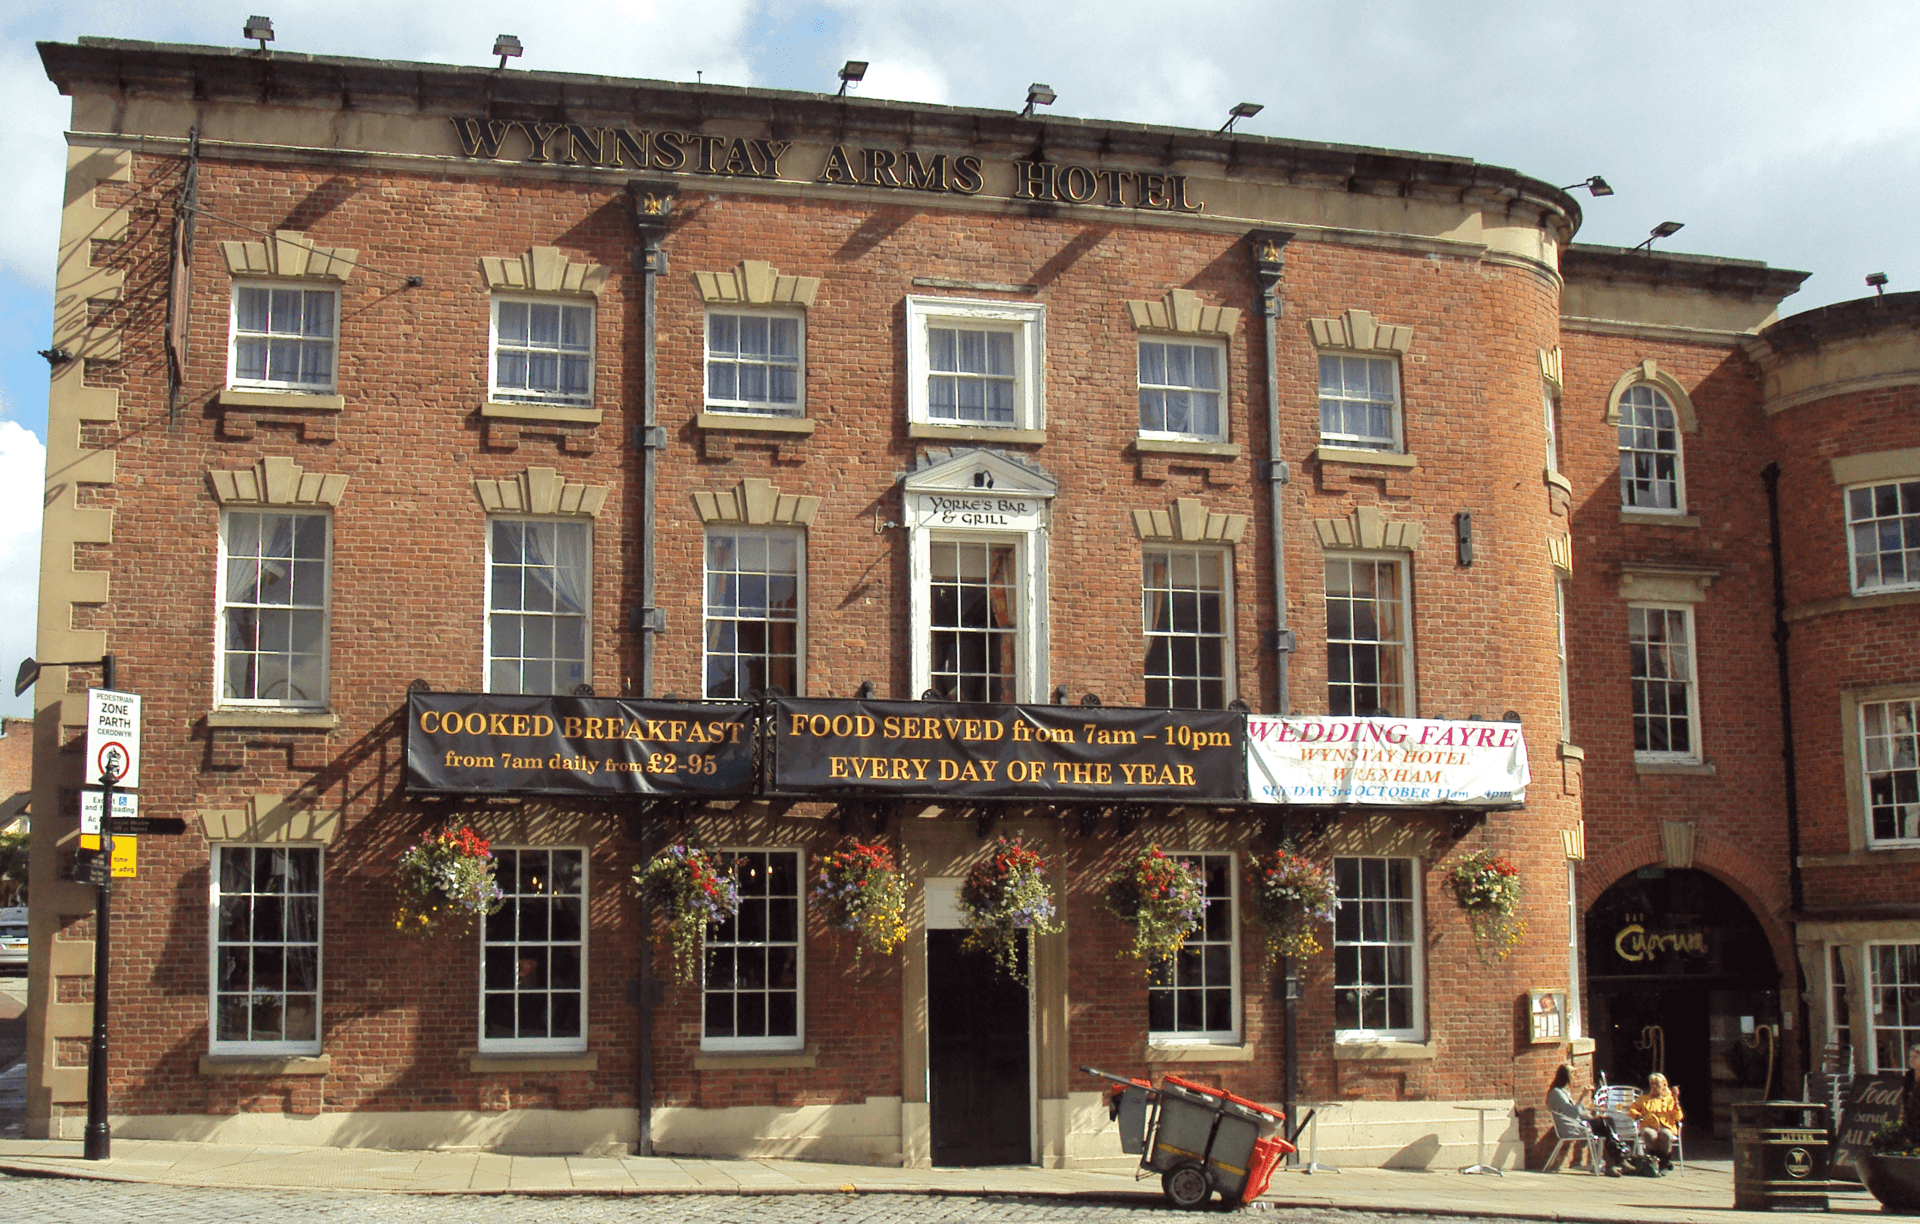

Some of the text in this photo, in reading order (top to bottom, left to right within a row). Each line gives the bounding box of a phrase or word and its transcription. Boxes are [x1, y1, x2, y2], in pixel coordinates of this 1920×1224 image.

[449, 116, 1206, 212] WYNNSTAY ARMS HOTEL
[942, 509, 957, 523] &
[96, 692, 134, 704] PEDESTRIAN
[101, 702, 129, 715] ZONE
[99, 715, 131, 728] PARTH
[420, 710, 744, 745] COOKED BREAKFAST
[789, 713, 875, 738] FOOD
[883, 716, 1004, 742] SERVED
[1012, 720, 1075, 744] from
[1083, 723, 1137, 745] 7am
[1164, 725, 1232, 751] 10pm
[1249, 721, 1519, 748] WEDDING FAYRE
[444, 750, 495, 769] from
[501, 752, 543, 769] 7am
[549, 753, 599, 775] daily
[604, 758, 642, 773] from
[1300, 747, 1471, 765] WYNSTAY HOTEL
[828, 756, 1197, 786] EVERY DAY OF THE YEAR
[1332, 767, 1443, 783] WREXHAM
[1354, 785, 1430, 798] OCTOBER
[1781, 1132, 1814, 1141] LITTER
